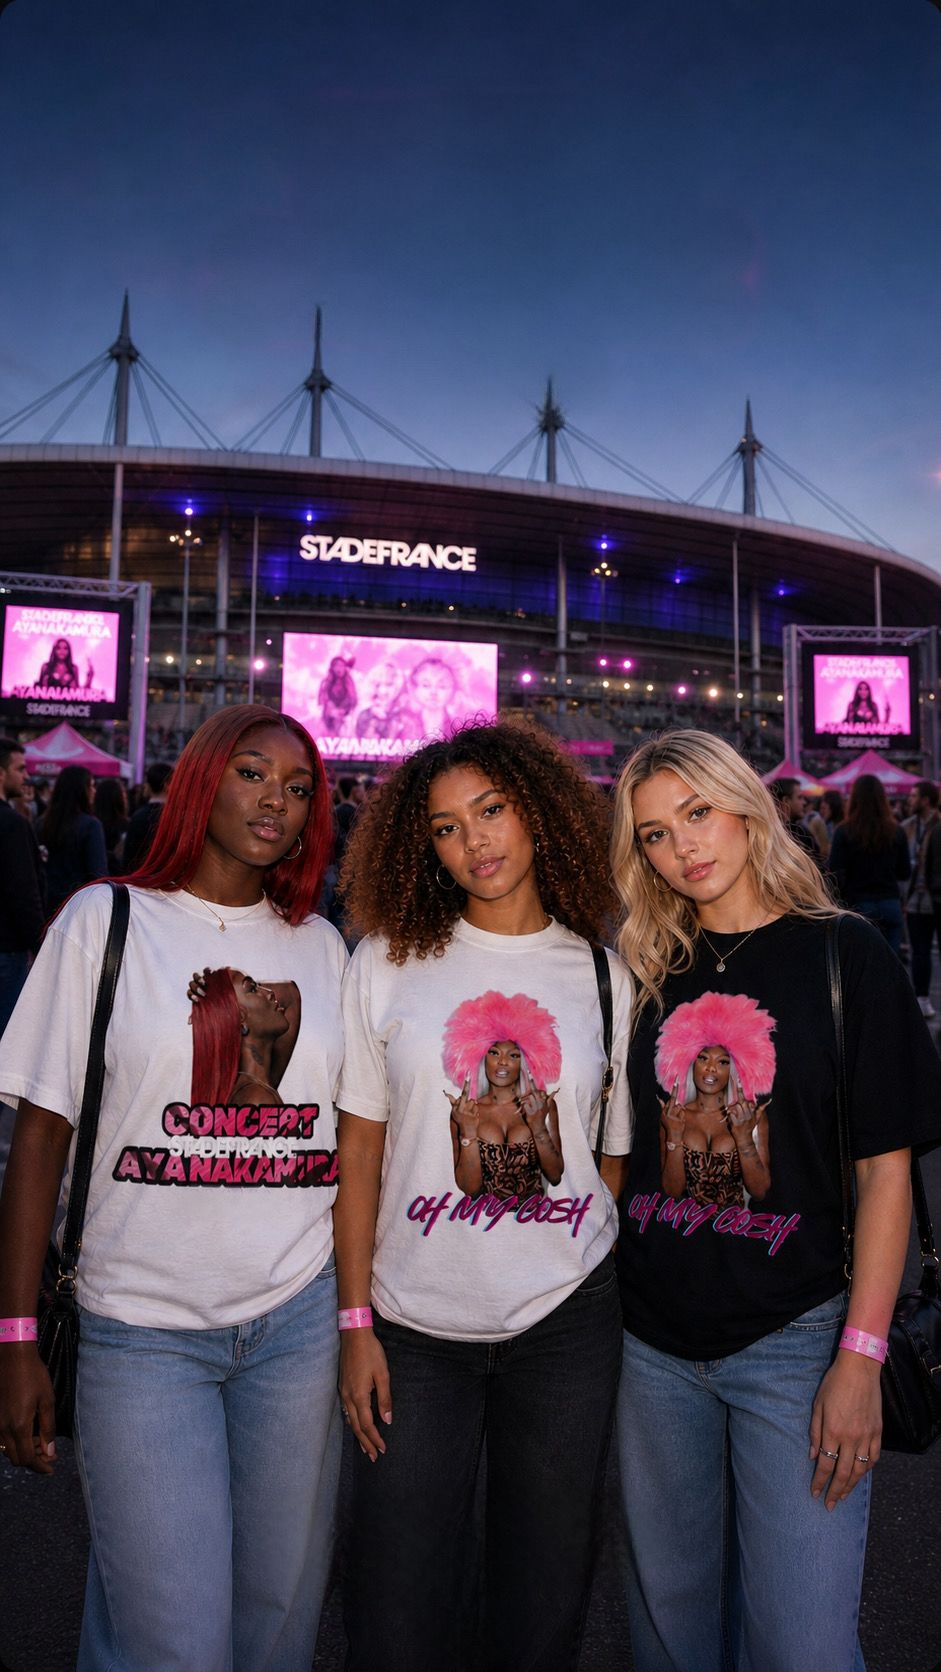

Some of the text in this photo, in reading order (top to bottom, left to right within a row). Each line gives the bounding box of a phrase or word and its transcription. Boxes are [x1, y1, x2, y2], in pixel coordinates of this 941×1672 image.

[300, 535, 477, 572] STADEFRANCE
[162, 1102, 319, 1139] CONCERT
[407, 1192, 453, 1237] OH
[449, 1193, 518, 1232] MY
[628, 1192, 661, 1235] OH
[656, 1197, 719, 1237] MY
